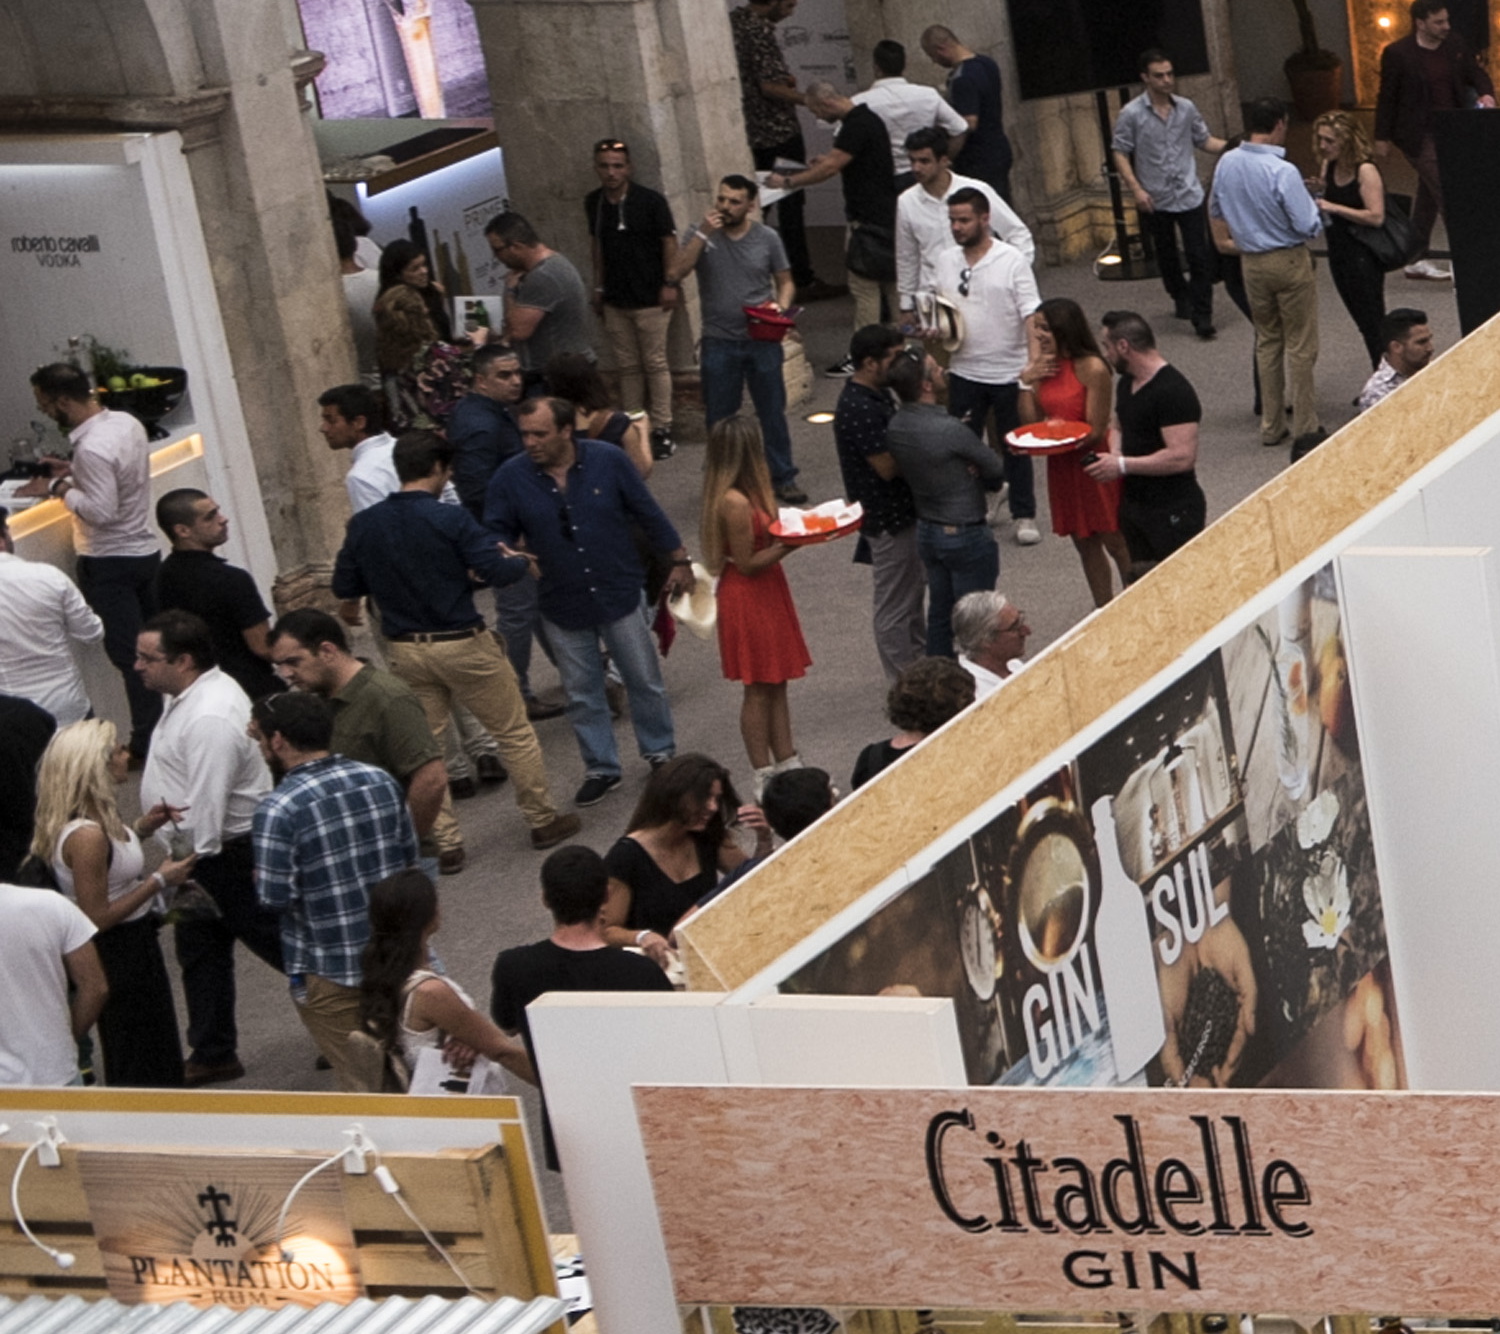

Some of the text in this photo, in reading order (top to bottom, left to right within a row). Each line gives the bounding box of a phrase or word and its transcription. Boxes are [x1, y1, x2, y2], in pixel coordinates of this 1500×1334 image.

[11, 234, 58, 254] roberto
[36, 254, 82, 268] VODKA
[1022, 843, 1229, 1080] GIN SUL
[923, 1108, 1315, 1238] Citadelle
[129, 1256, 337, 1291] PLANTATION
[1062, 1250, 1202, 1291] GIN
[212, 1290, 269, 1306] RUM
